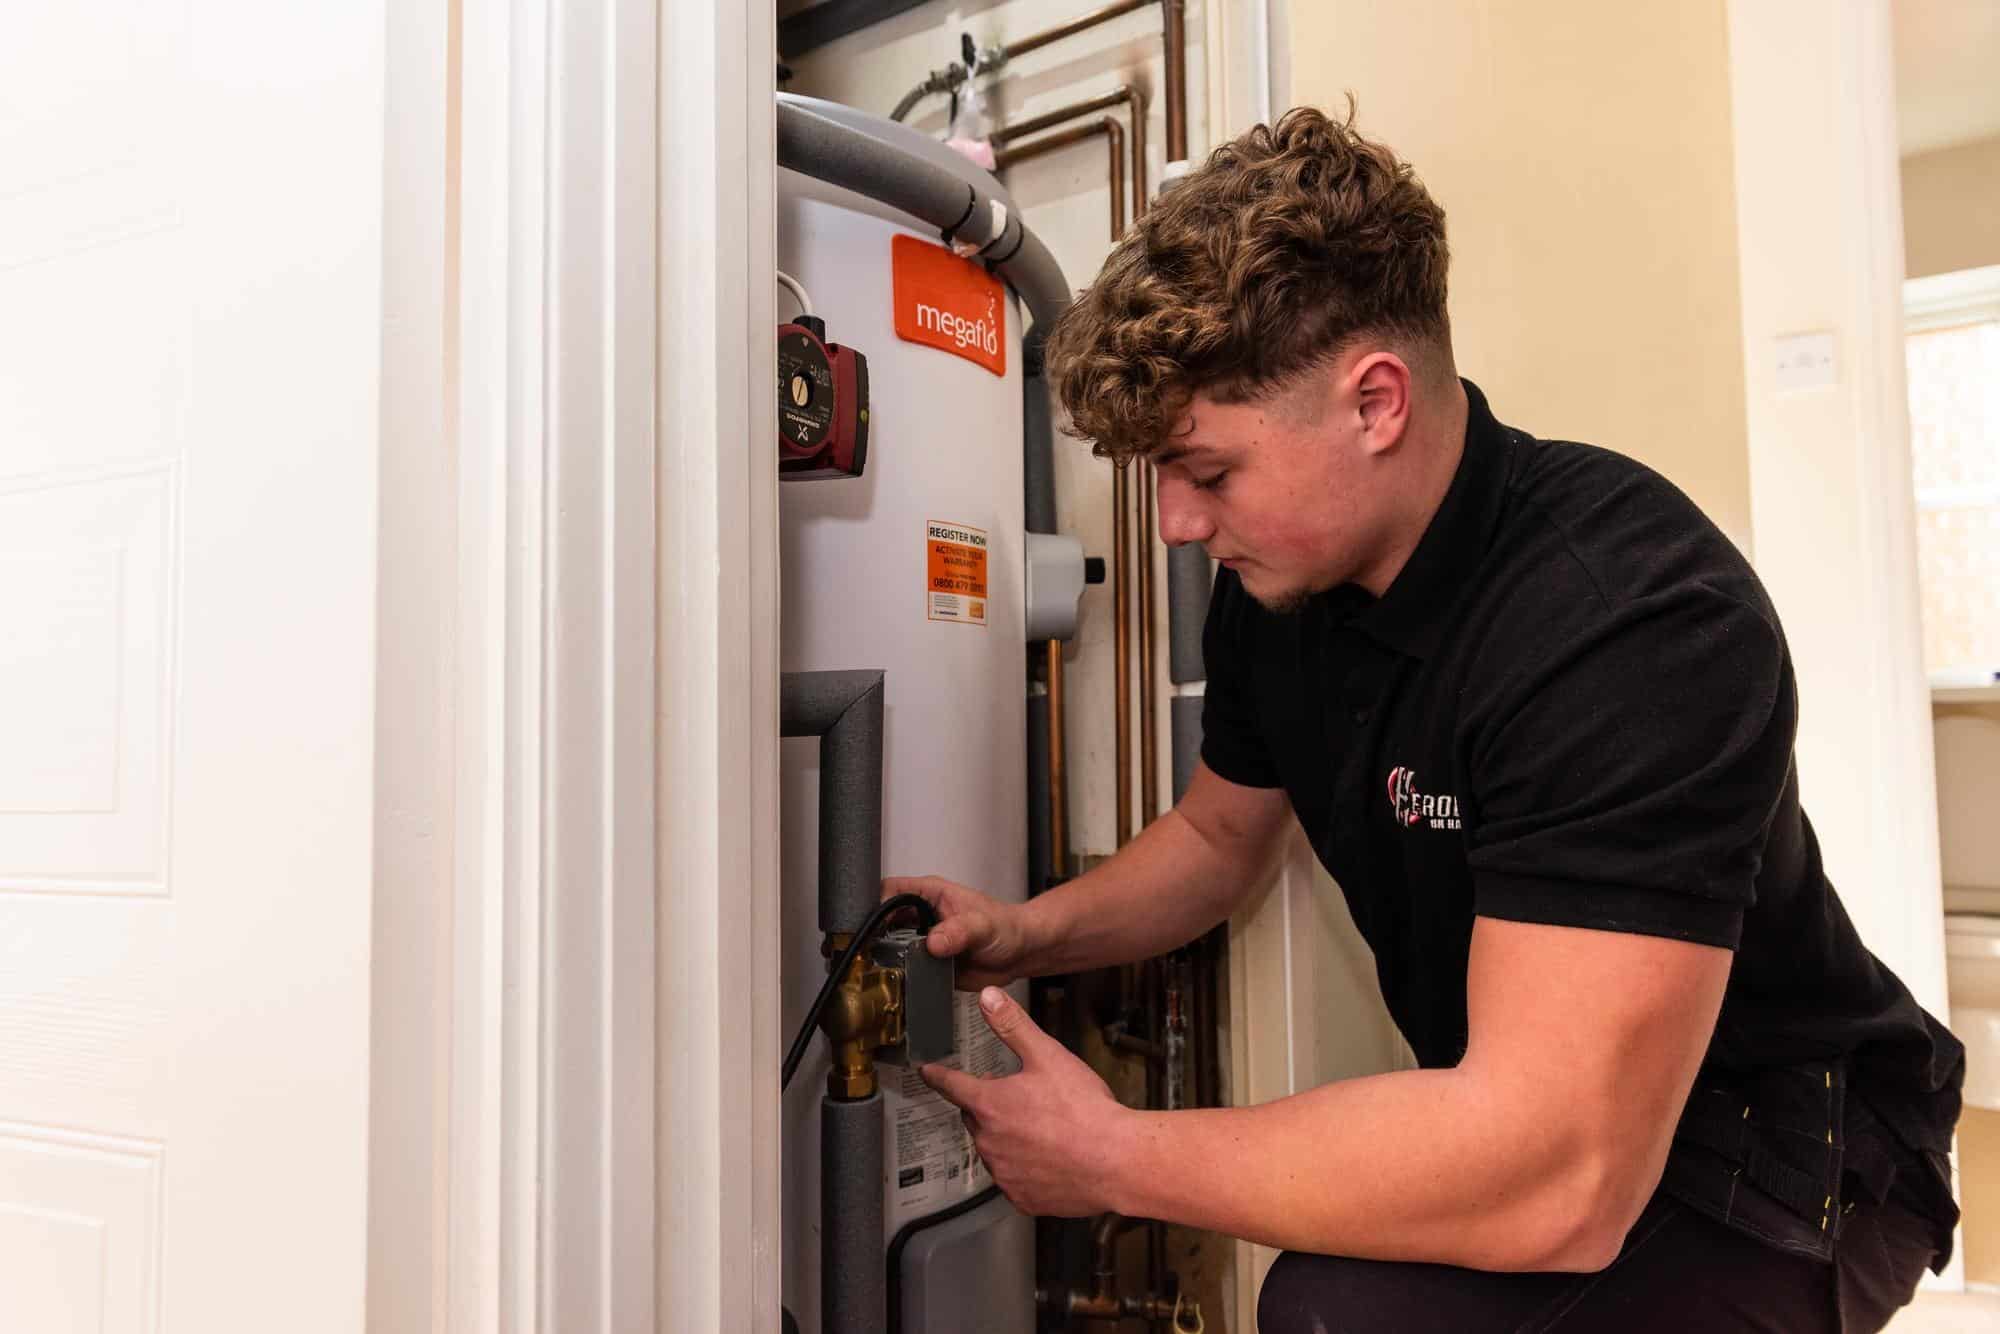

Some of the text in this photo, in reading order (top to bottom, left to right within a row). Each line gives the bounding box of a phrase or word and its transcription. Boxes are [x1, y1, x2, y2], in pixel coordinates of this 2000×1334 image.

[917, 303, 997, 355] megaflo
[930, 527, 986, 546] REGISTER NOW
